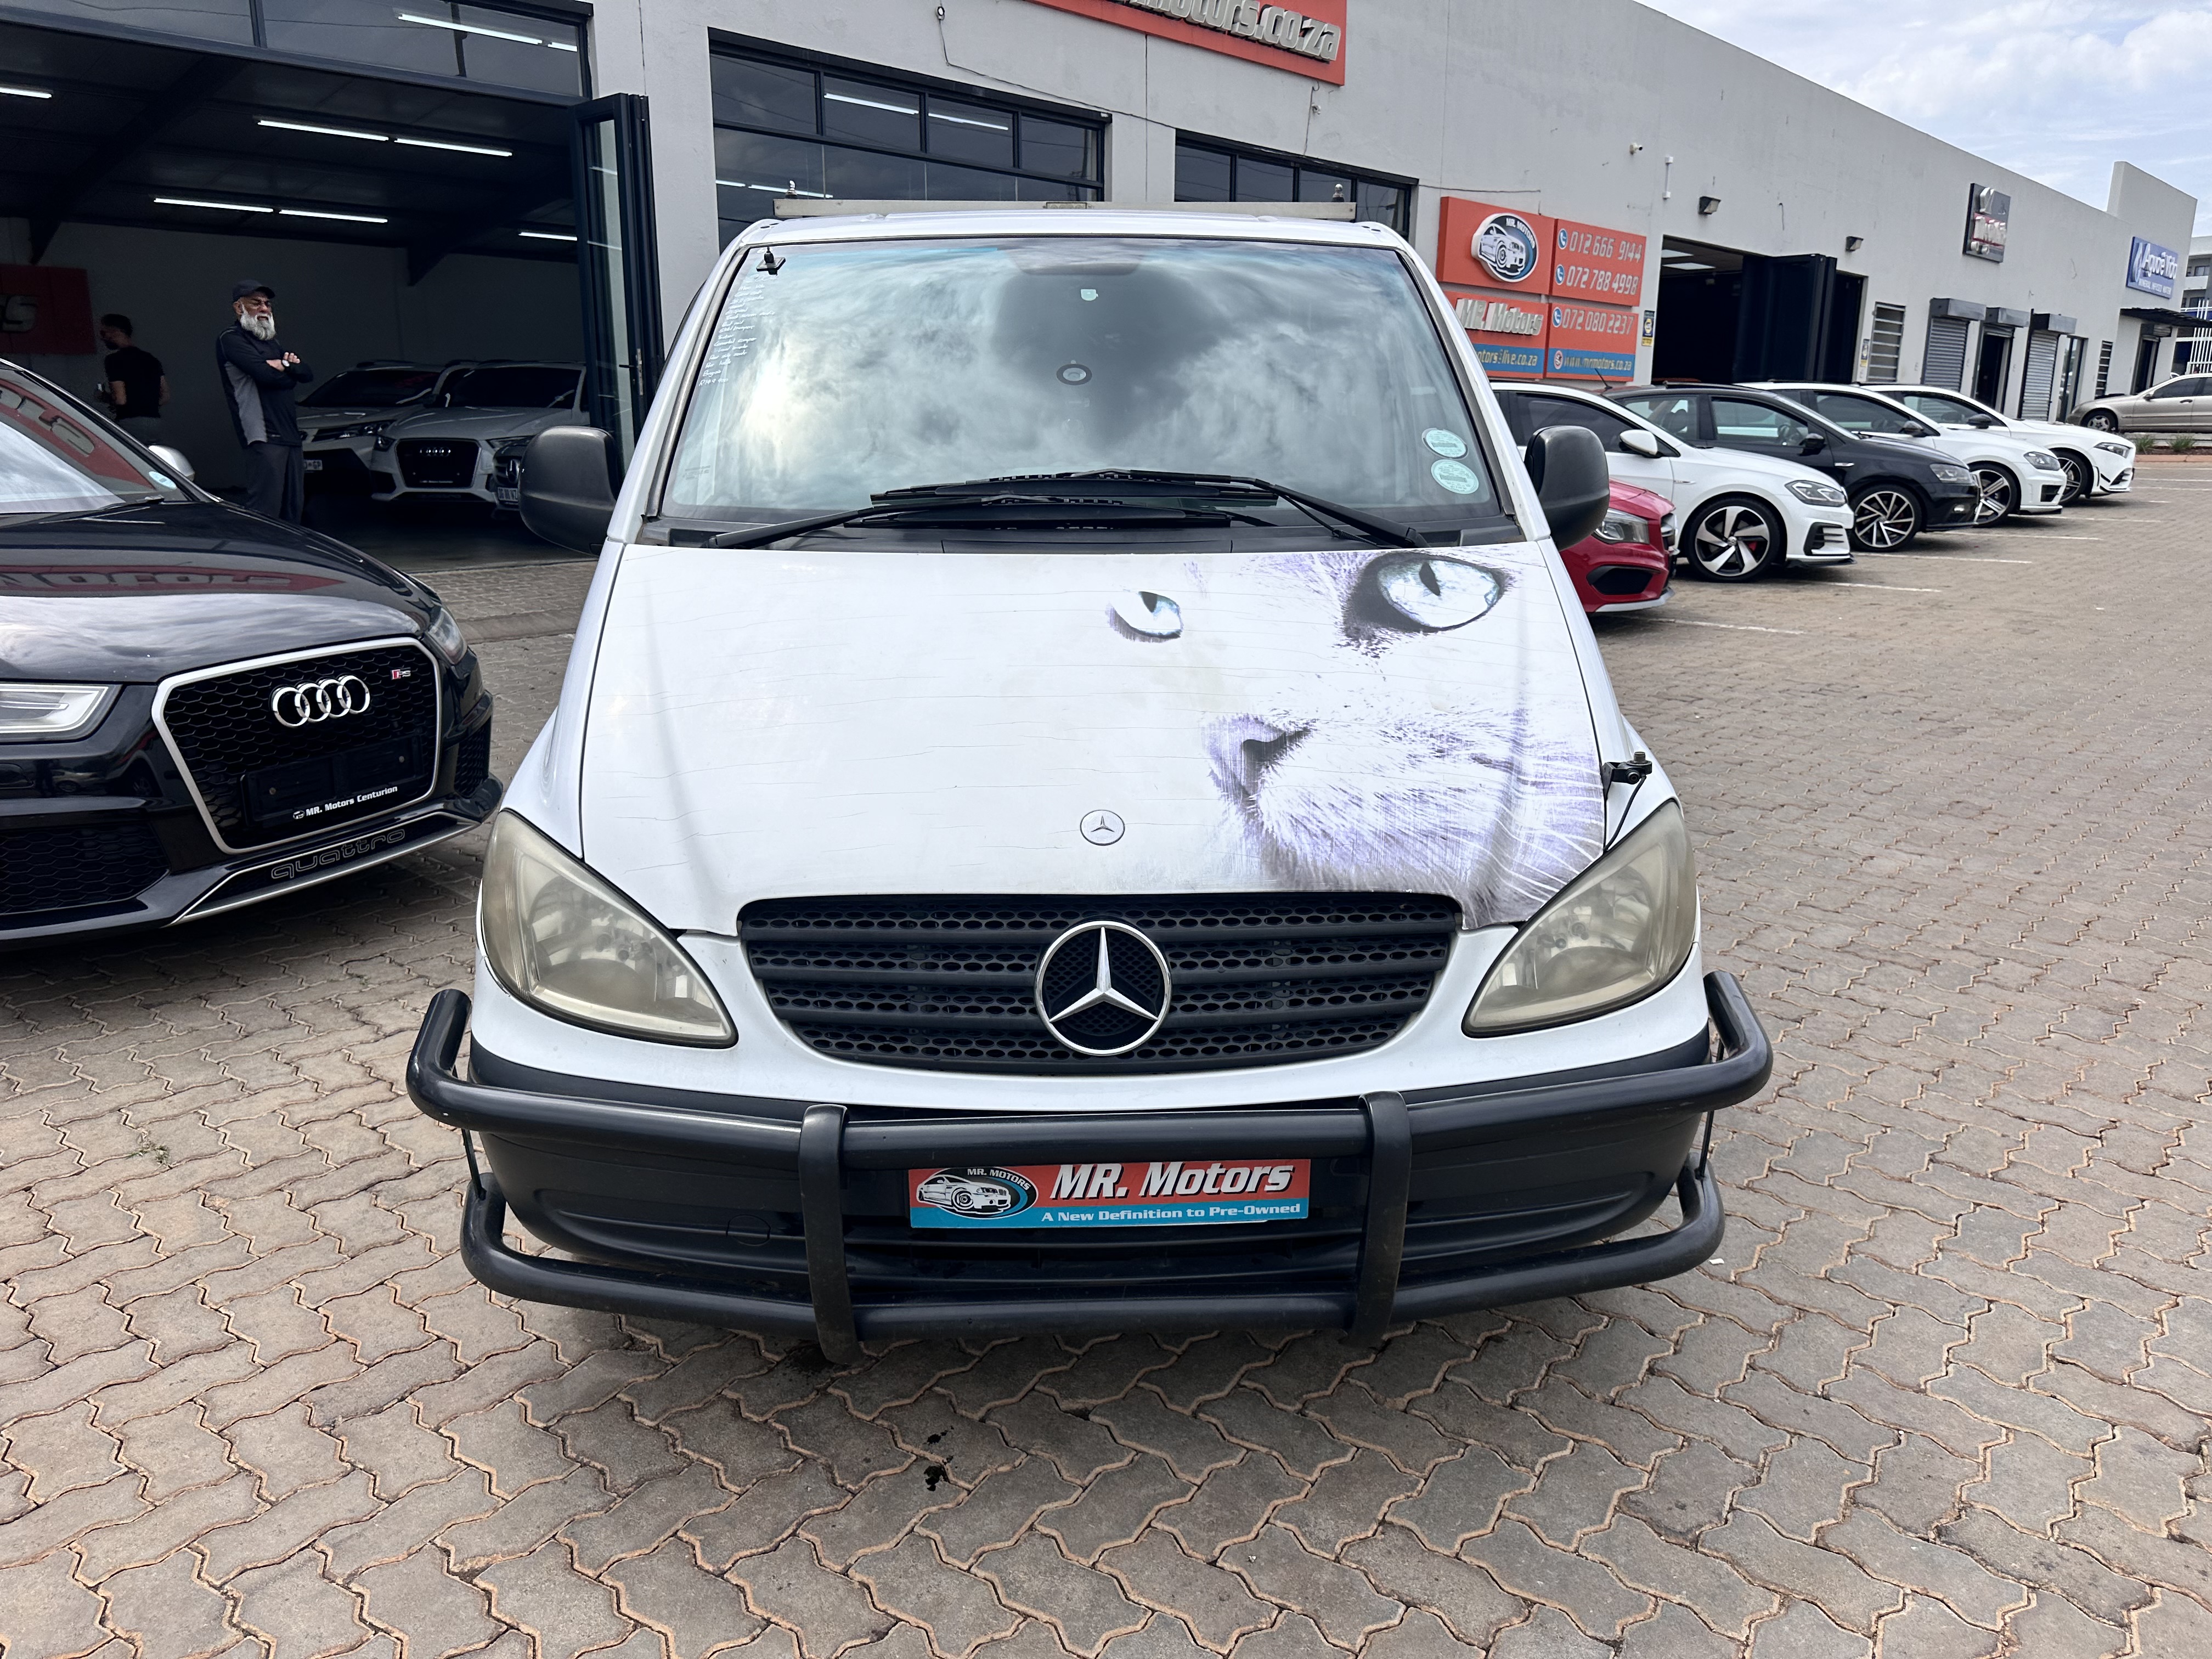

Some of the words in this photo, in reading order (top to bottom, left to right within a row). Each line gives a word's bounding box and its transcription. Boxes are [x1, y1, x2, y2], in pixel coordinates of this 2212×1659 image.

[1569, 231, 1593, 254] 012
[1593, 235, 1615, 258] 666
[1618, 240, 1643, 263] 9144
[1566, 266, 1590, 289] 072
[1589, 269, 1612, 291] 788
[1611, 273, 1639, 295] 4998
[1486, 302, 1544, 336] Motors
[1562, 308, 1585, 330] 072
[1585, 311, 1607, 332] 080
[1607, 313, 1635, 335] 2237
[306, 806, 323, 816] MR.
[324, 798, 354, 811] Motors
[357, 786, 398, 803] Centurion
[271, 829, 405, 879] quattro
[989, 1169, 1031, 1190] MOTORS
[1049, 1163, 1129, 1199] MR.
[1138, 1161, 1294, 1197] Motors
[1041, 1211, 1054, 1222] A
[1058, 1211, 1094, 1221] New
[1098, 1209, 1183, 1221] Definition
[1186, 1208, 1205, 1217] to
[1209, 1203, 1300, 1217] Pre-Owned
